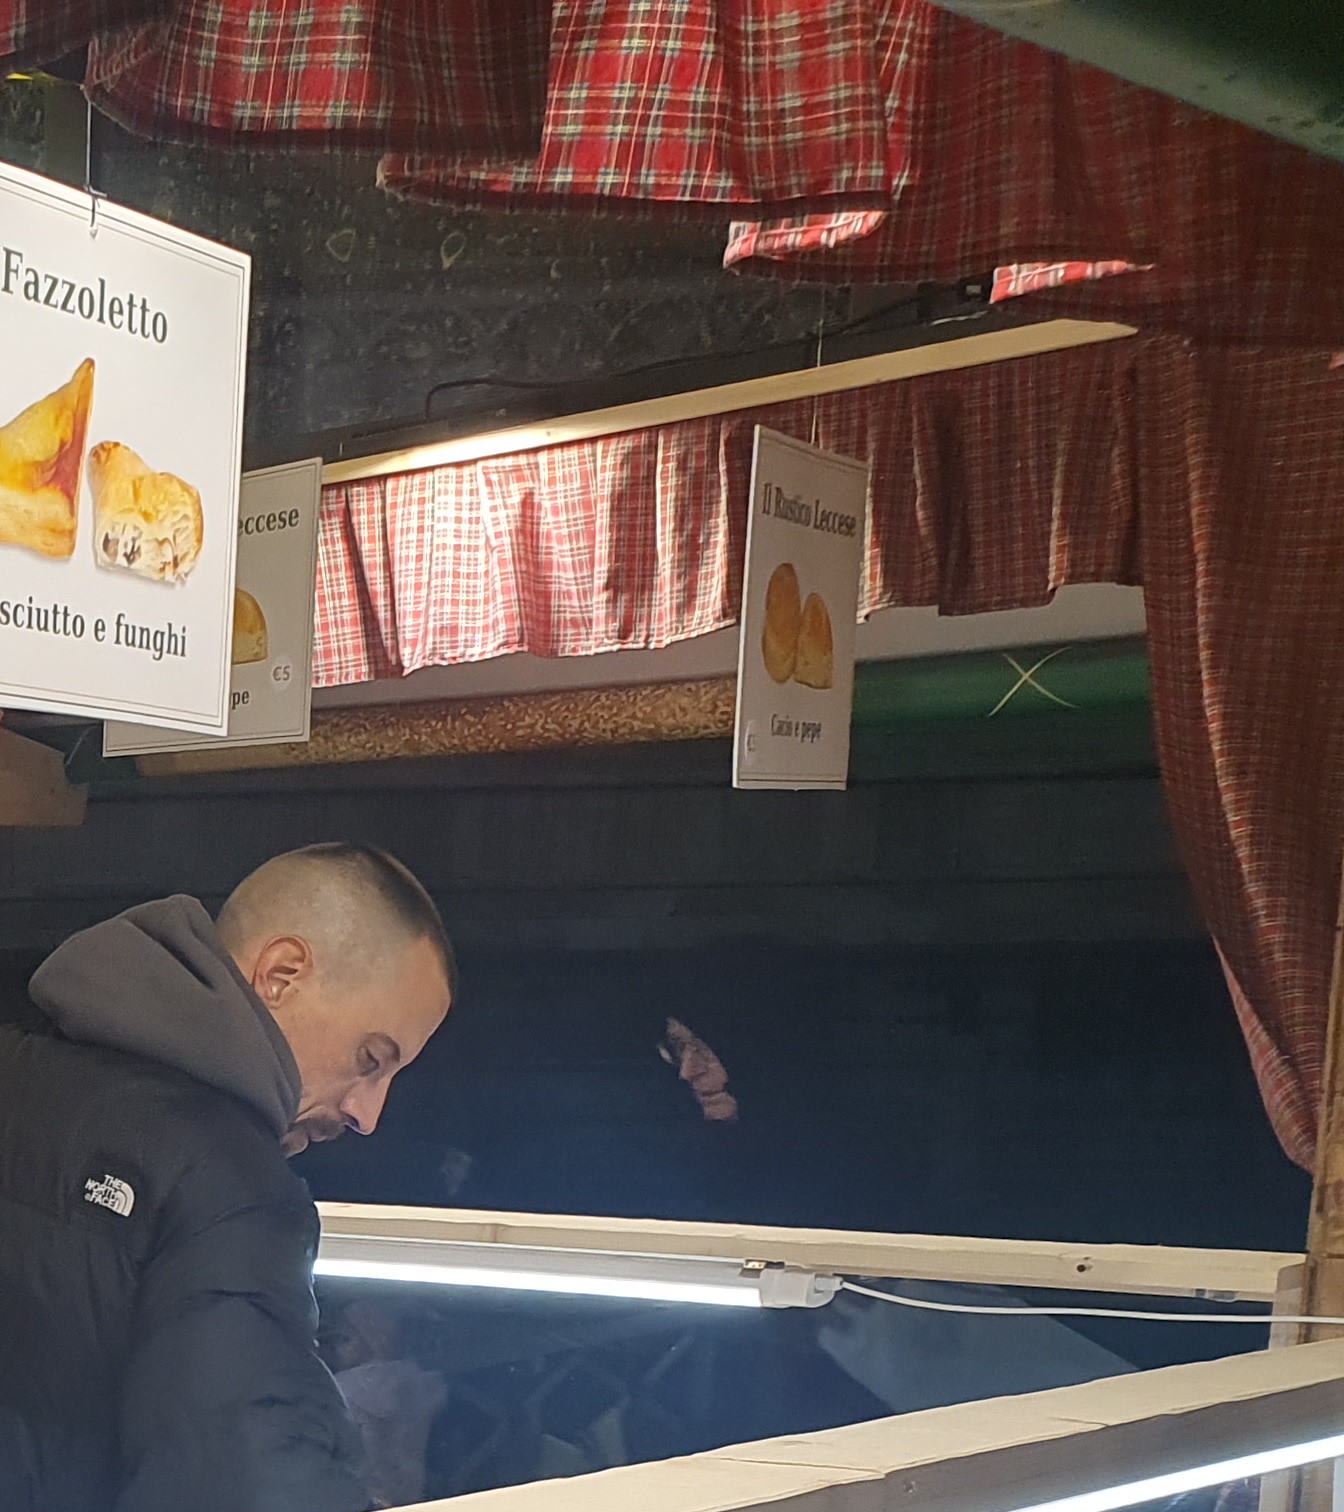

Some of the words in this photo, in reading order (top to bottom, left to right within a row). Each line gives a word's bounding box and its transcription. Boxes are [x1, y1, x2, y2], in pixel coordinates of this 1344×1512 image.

[1, 246, 168, 344] Fazzoletto
[813, 499, 856, 537] Leccese
[93, 617, 106, 642] e
[114, 613, 187, 661] funghi
[273, 665, 290, 681] €5
[84, 1177, 117, 1200] NORTH
[104, 1174, 123, 1190] THE
[90, 1190, 117, 1209] FACE
